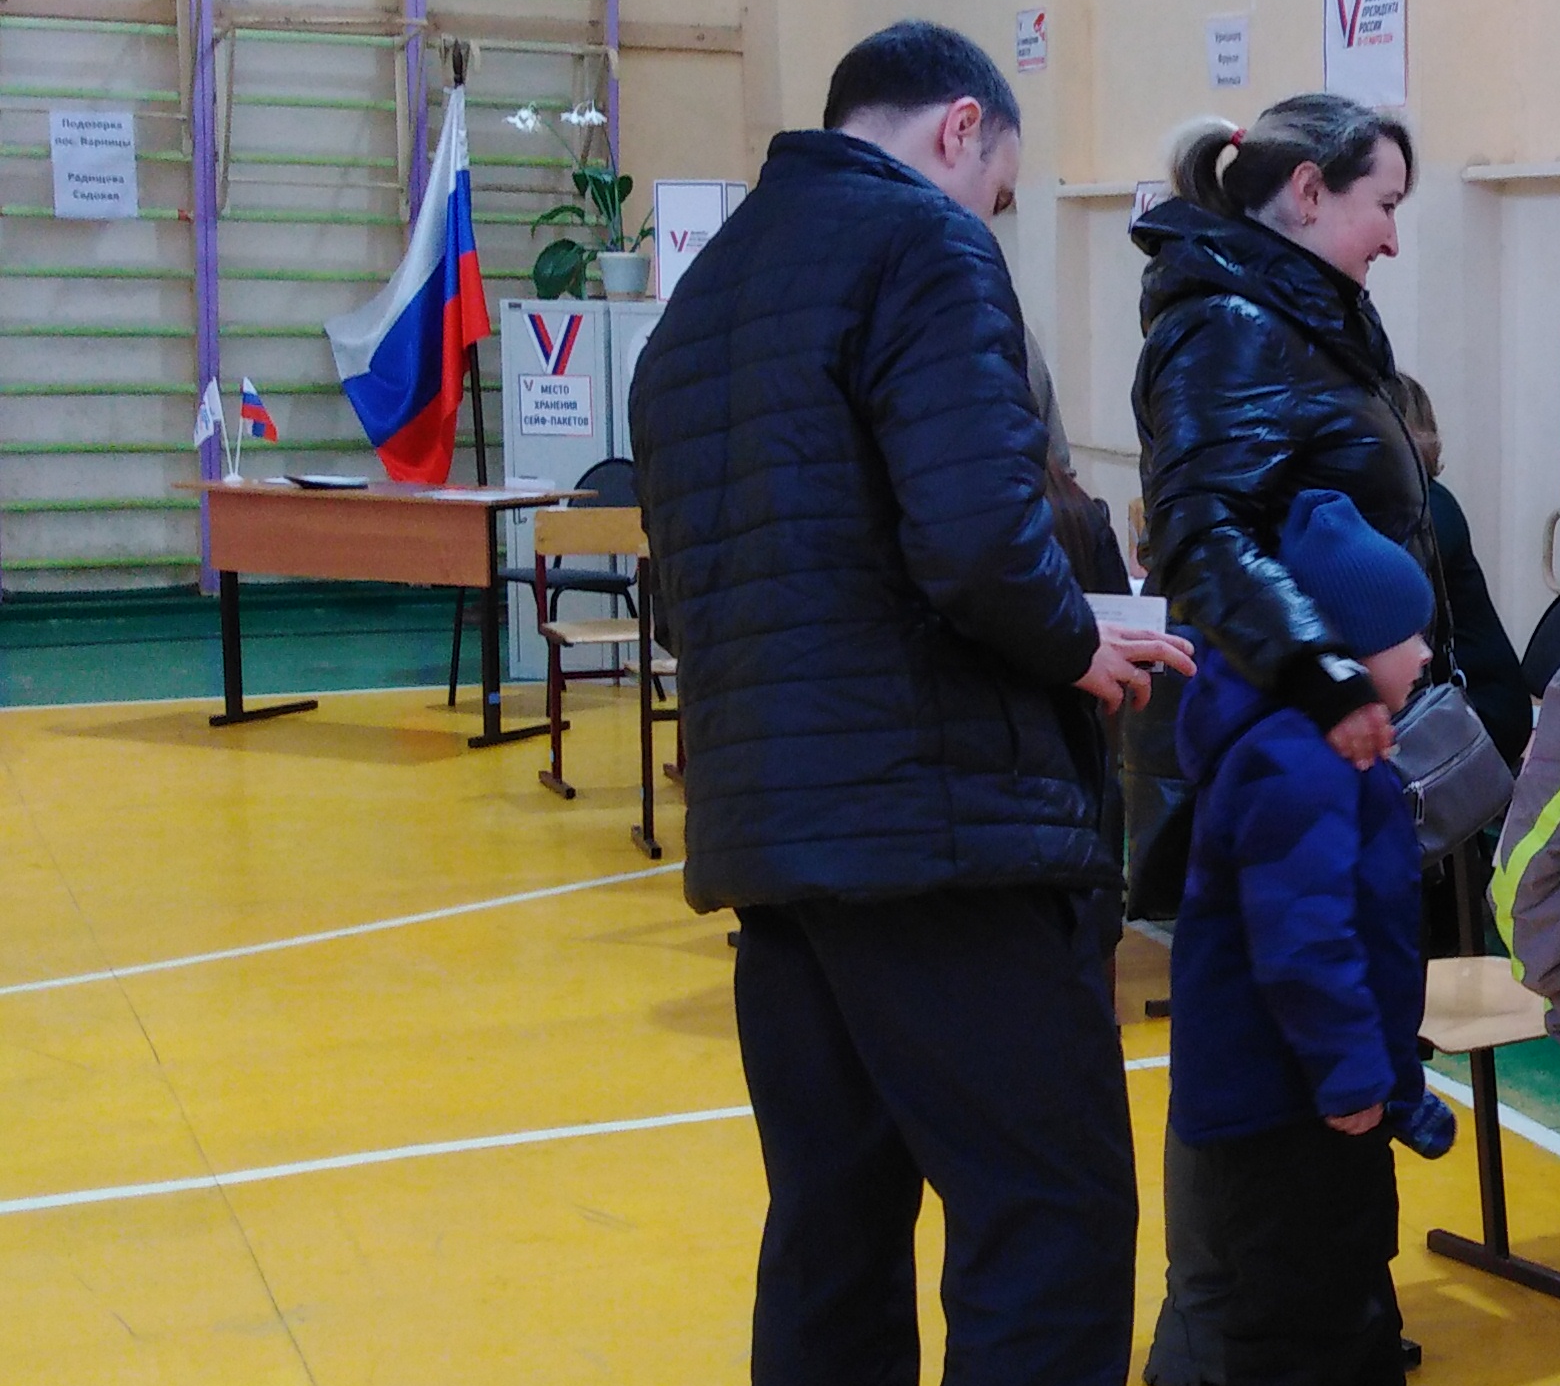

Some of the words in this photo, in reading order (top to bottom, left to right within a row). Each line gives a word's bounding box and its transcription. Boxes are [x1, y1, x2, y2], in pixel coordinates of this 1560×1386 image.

[540, 384, 570, 395] МЕСТО
[534, 400, 578, 411] ХРАНЕНИЯ
[523, 413, 589, 427] СЕЙФ-ПАКЕТОВ
